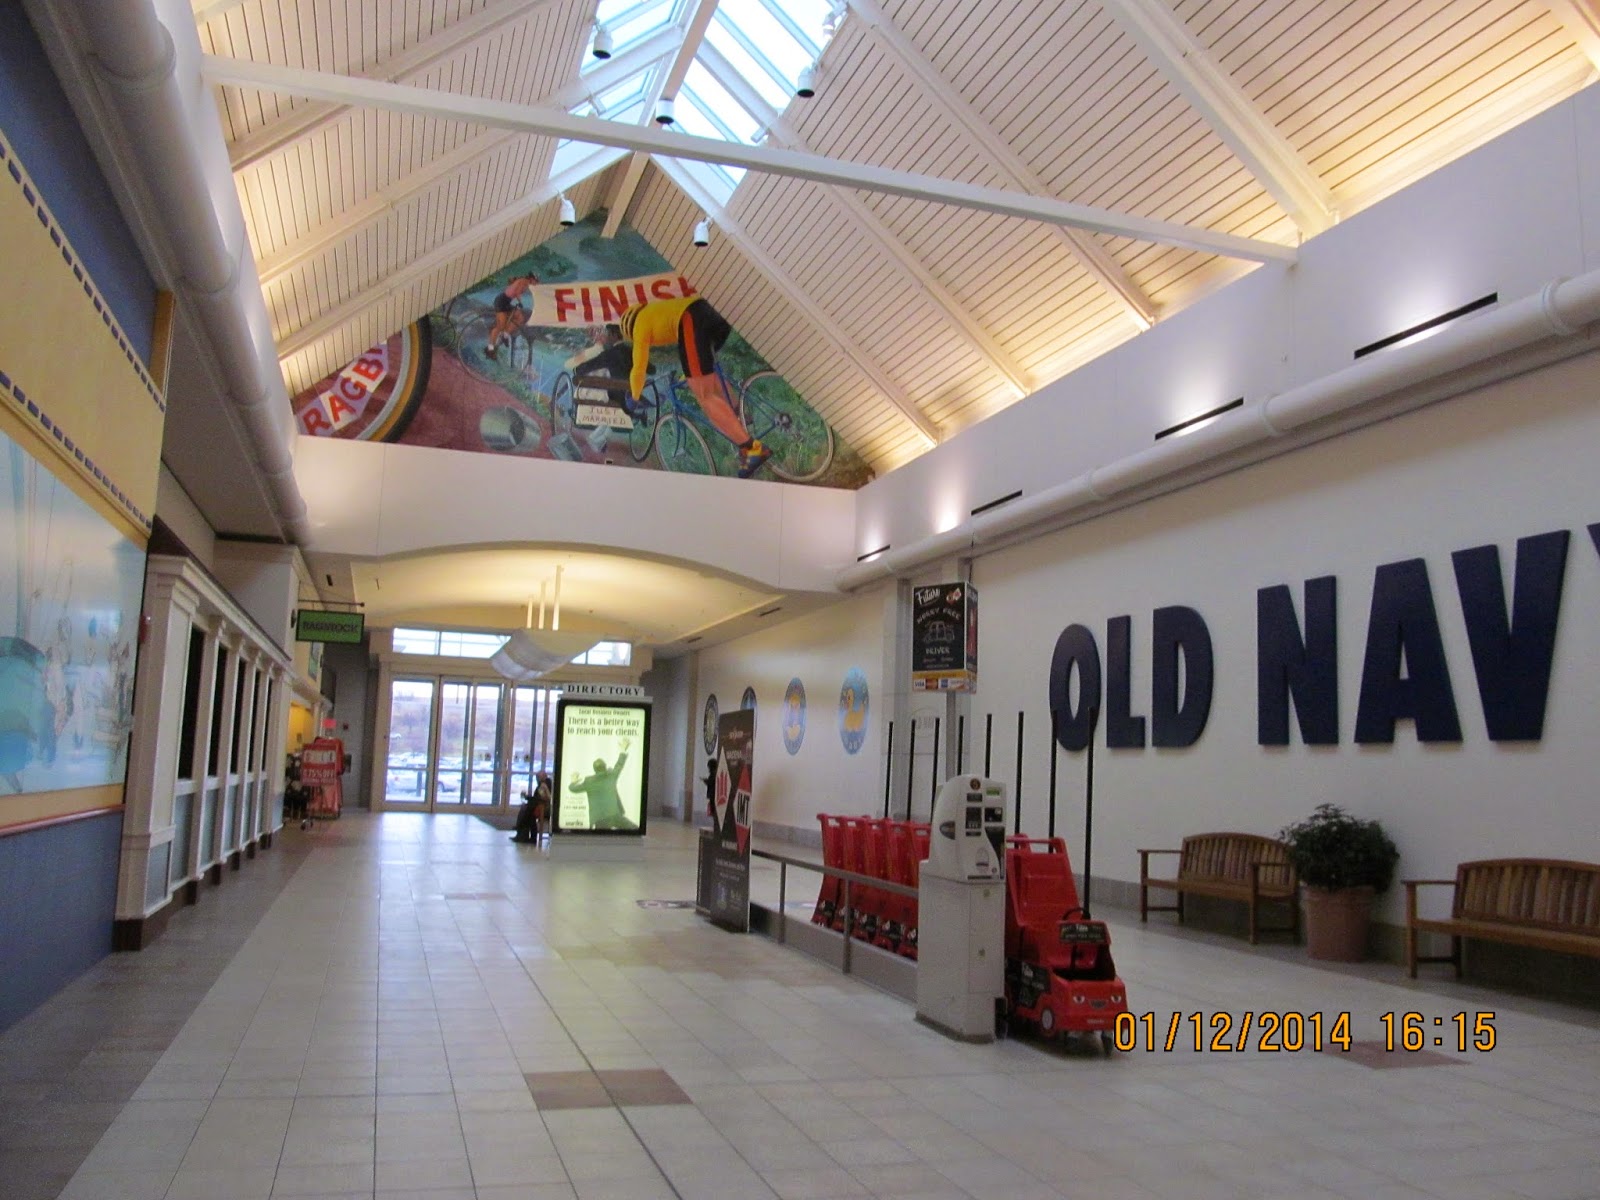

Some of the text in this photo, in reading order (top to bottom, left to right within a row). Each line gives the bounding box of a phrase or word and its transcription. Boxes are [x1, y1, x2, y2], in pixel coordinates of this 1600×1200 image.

[582, 415, 626, 425] MARRIED
[1049, 522, 1600, 752] OLD NAV
[567, 685, 641, 696] DIRECTORY
[568, 717, 588, 725] There
[589, 717, 596, 725] is
[603, 718, 624, 726] better
[626, 719, 640, 727] way
[567, 726, 574, 735] to
[576, 727, 596, 735] reach
[597, 728, 613, 736] your
[736, 791, 750, 827] IMT
